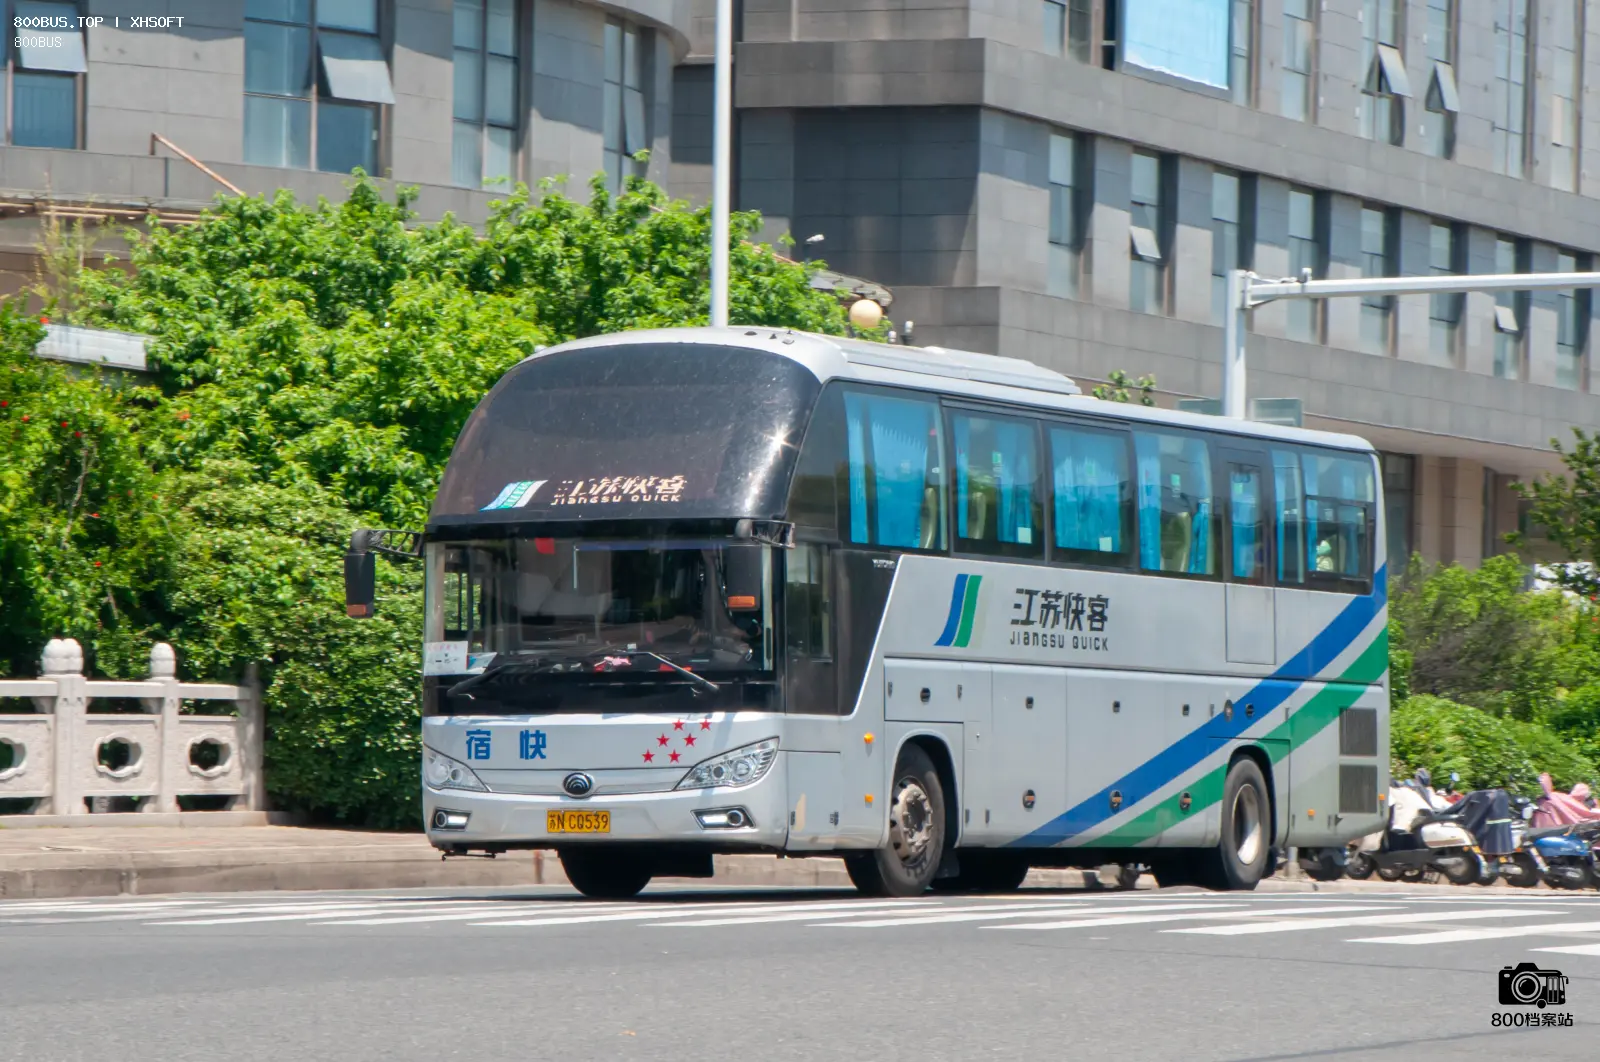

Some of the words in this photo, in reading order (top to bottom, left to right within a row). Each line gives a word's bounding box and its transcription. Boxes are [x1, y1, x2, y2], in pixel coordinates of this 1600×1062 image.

[1010, 587, 1110, 632] 江苏快客
[1072, 636, 1109, 651] QUICK
[465, 729, 547, 760] 宿快
